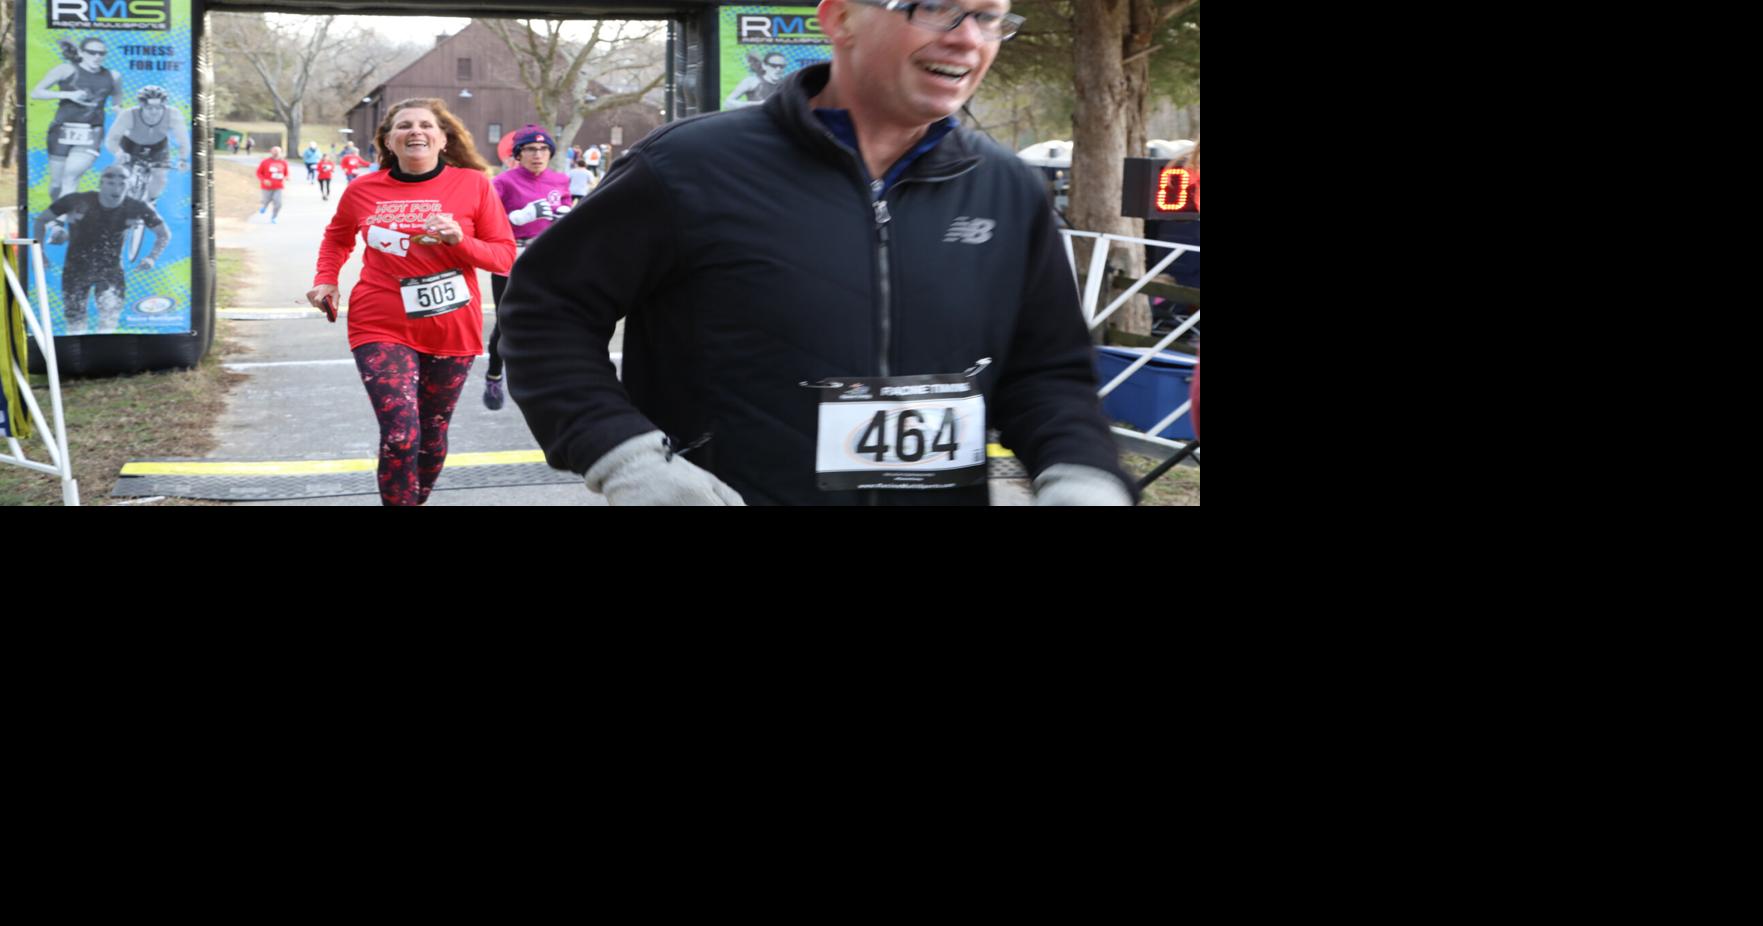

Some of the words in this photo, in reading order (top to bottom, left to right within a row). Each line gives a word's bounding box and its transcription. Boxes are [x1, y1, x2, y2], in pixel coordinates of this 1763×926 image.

[52, 0, 167, 22] RMS
[129, 60, 153, 71] FOR
[375, 203, 408, 214] HOT
[410, 202, 442, 212] FOR
[417, 282, 456, 307] 505
[856, 408, 959, 462] 464
